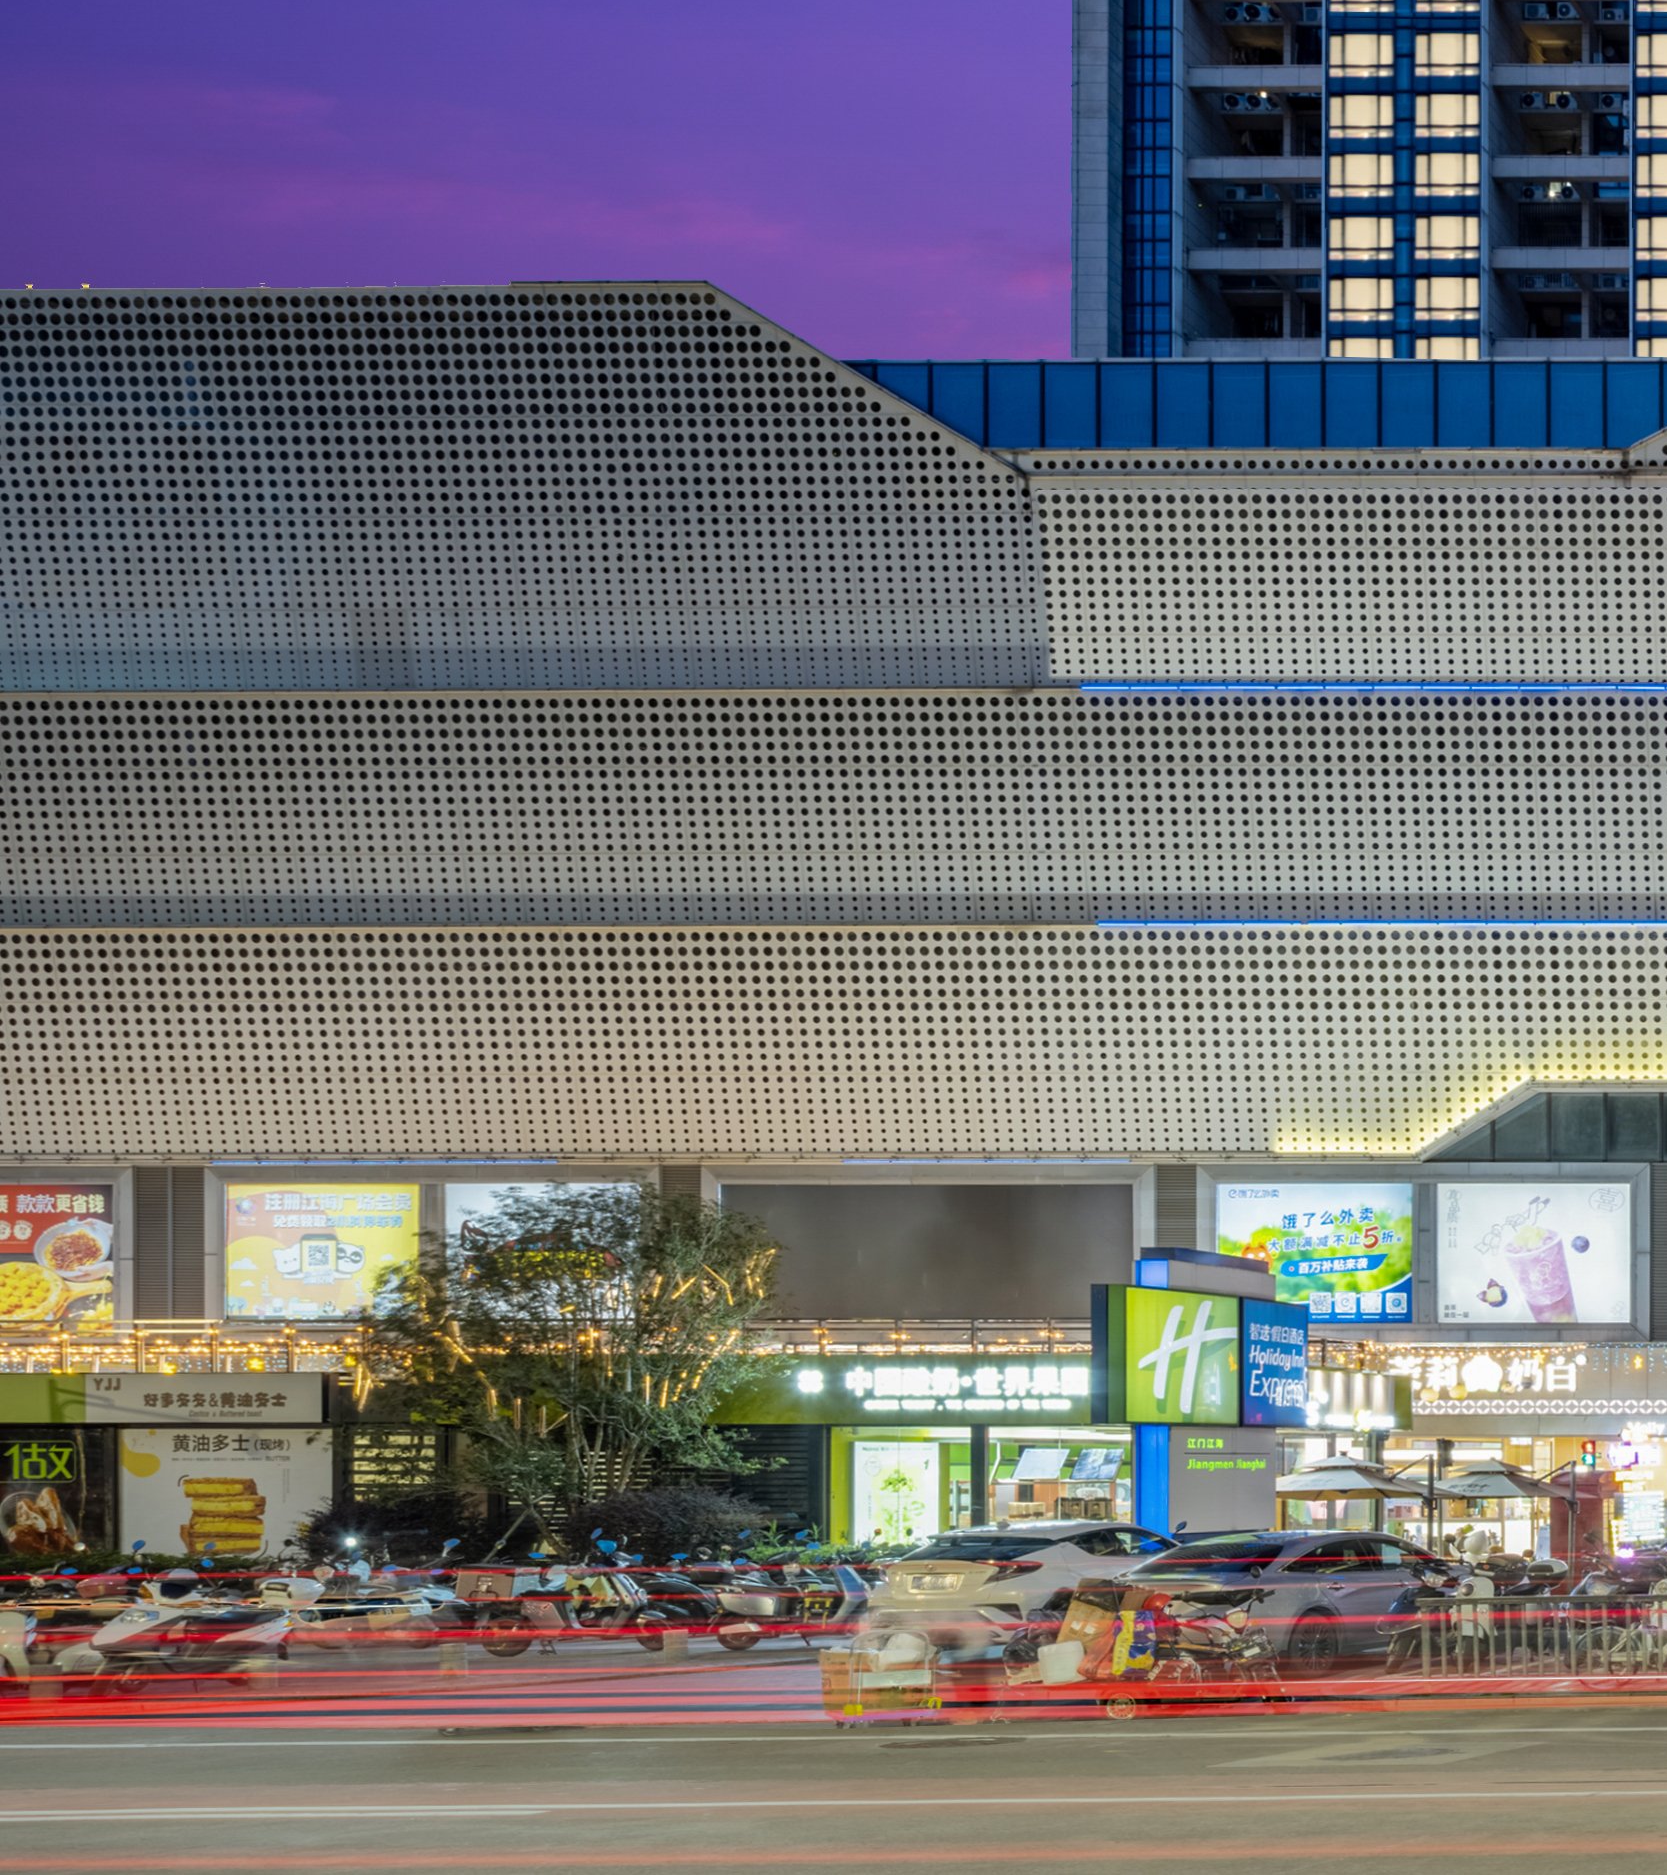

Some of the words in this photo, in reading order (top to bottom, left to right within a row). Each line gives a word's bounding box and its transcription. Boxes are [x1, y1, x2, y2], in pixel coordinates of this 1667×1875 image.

[16, 1194, 105, 1213] 款款更省钱
[265, 1193, 412, 1211] 注册江海广场会员
[1282, 1207, 1374, 1230] 饿了么外卖
[1298, 1258, 1369, 1275] 百万补贴来袭
[1249, 1323, 1305, 1345] 智选假日酒店
[1249, 1344, 1291, 1371] Holiday
[1292, 1350, 1305, 1368] Inn
[93, 1378, 121, 1391] YJJ
[1187, 1438, 1224, 1449] 江门江海
[1187, 1459, 1234, 1472] Jiangmen
[1236, 1459, 1266, 1472] Jianghai
